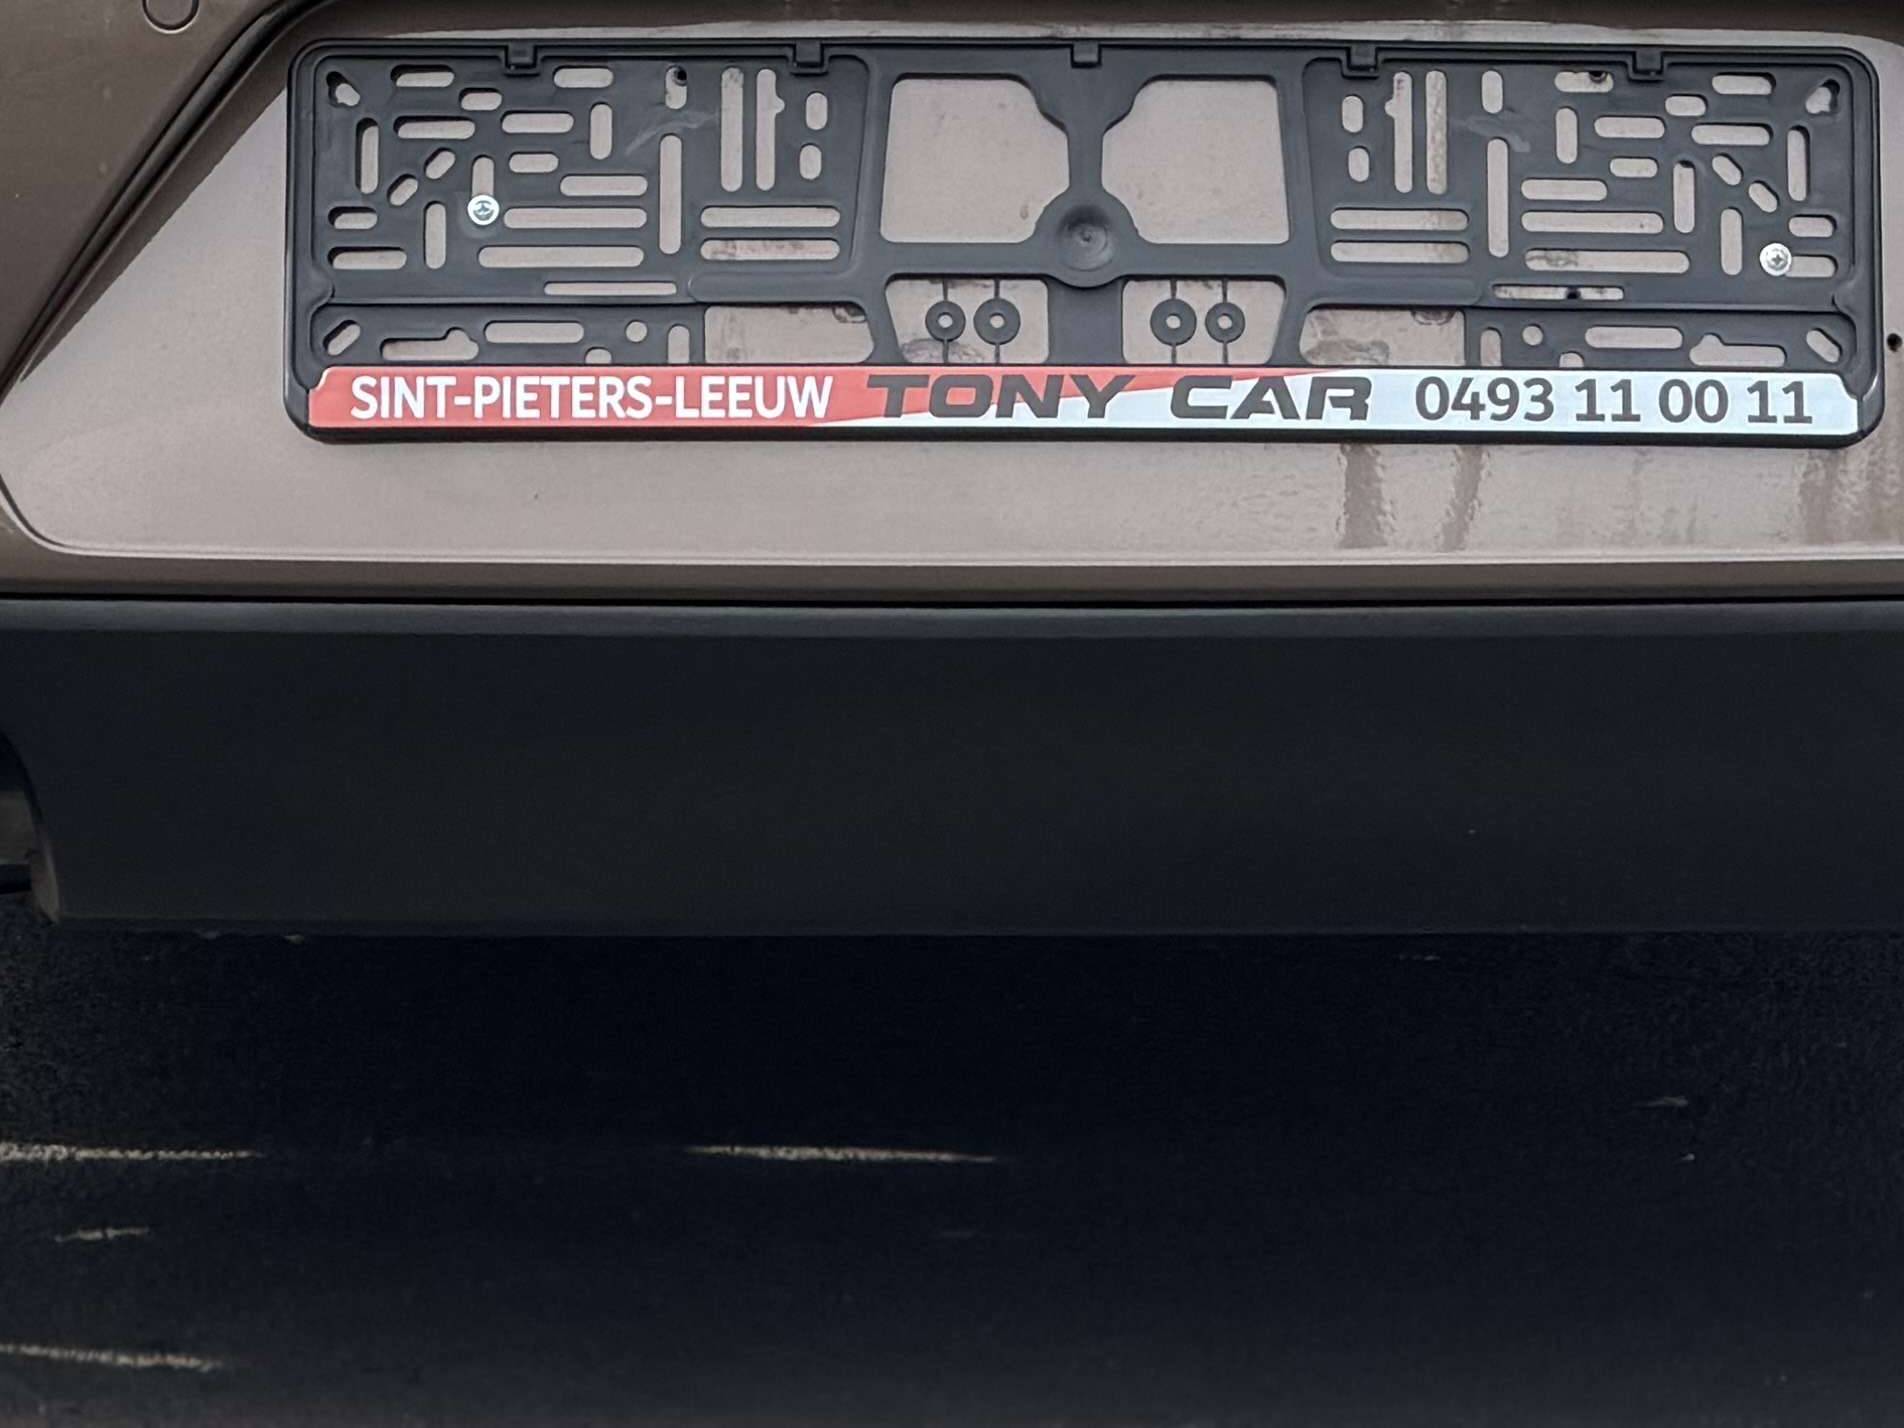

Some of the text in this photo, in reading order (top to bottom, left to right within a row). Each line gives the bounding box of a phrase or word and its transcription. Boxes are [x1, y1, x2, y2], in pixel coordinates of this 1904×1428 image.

[349, 373, 1813, 425] SINT-PIETERS-LEEUW TONY CAR 0493 11 00 11
